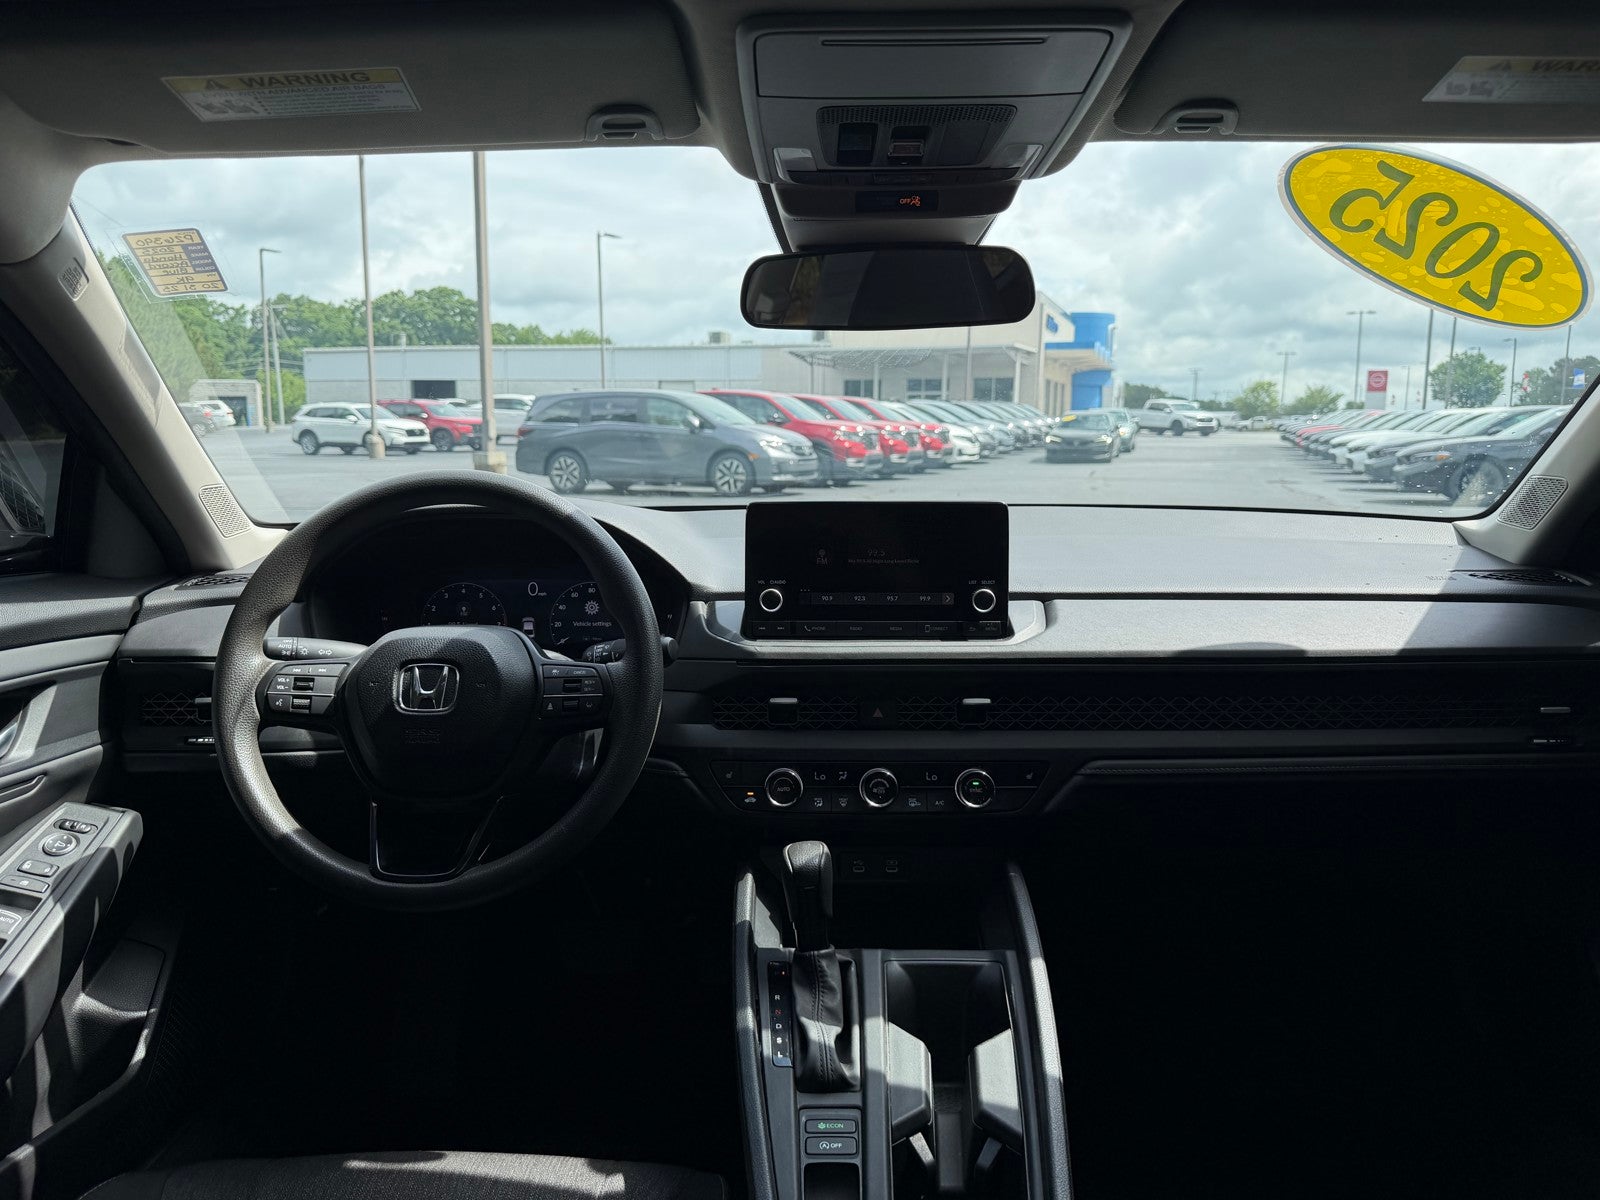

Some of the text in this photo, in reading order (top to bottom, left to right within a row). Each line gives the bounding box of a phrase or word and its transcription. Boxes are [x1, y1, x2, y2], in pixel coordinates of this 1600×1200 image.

[238, 71, 372, 89] WARNING
[268, 87, 329, 97] ADVANCED
[331, 85, 350, 93] AIR
[527, 581, 538, 596] 0
[592, 620, 612, 628] settings
[775, 1022, 783, 1030] D
